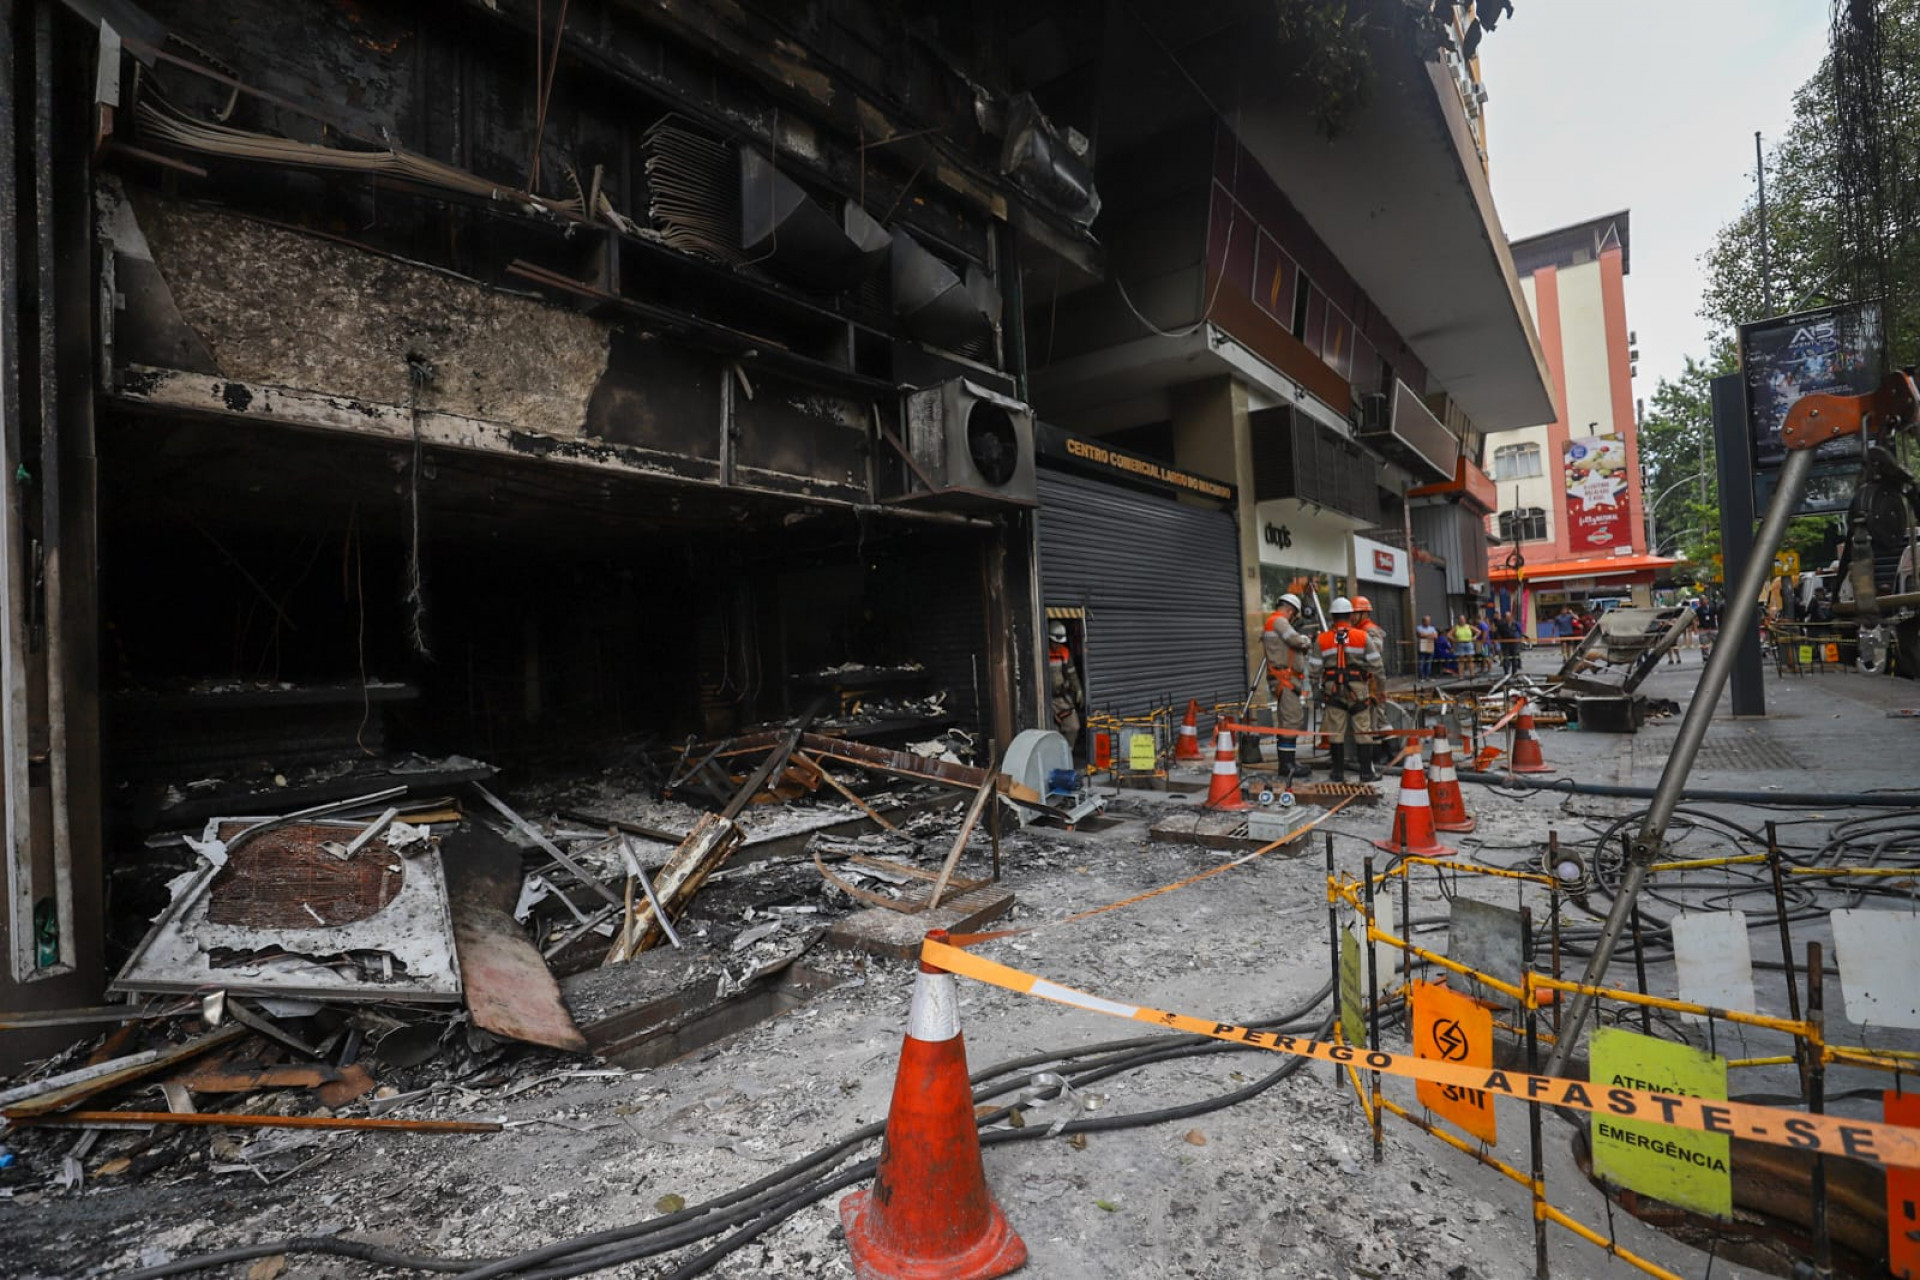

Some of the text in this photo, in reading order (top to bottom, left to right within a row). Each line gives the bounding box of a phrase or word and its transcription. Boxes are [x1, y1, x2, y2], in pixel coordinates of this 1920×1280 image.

[1066, 438, 1109, 464] CENTRO
[1110, 452, 1161, 479] COMERCIAL
[1213, 1023, 1880, 1160] PERIGO AFASTE-SE
[1612, 1074, 1702, 1099] ATEN
[1599, 1123, 1727, 1173] EMERGÊNCIA
